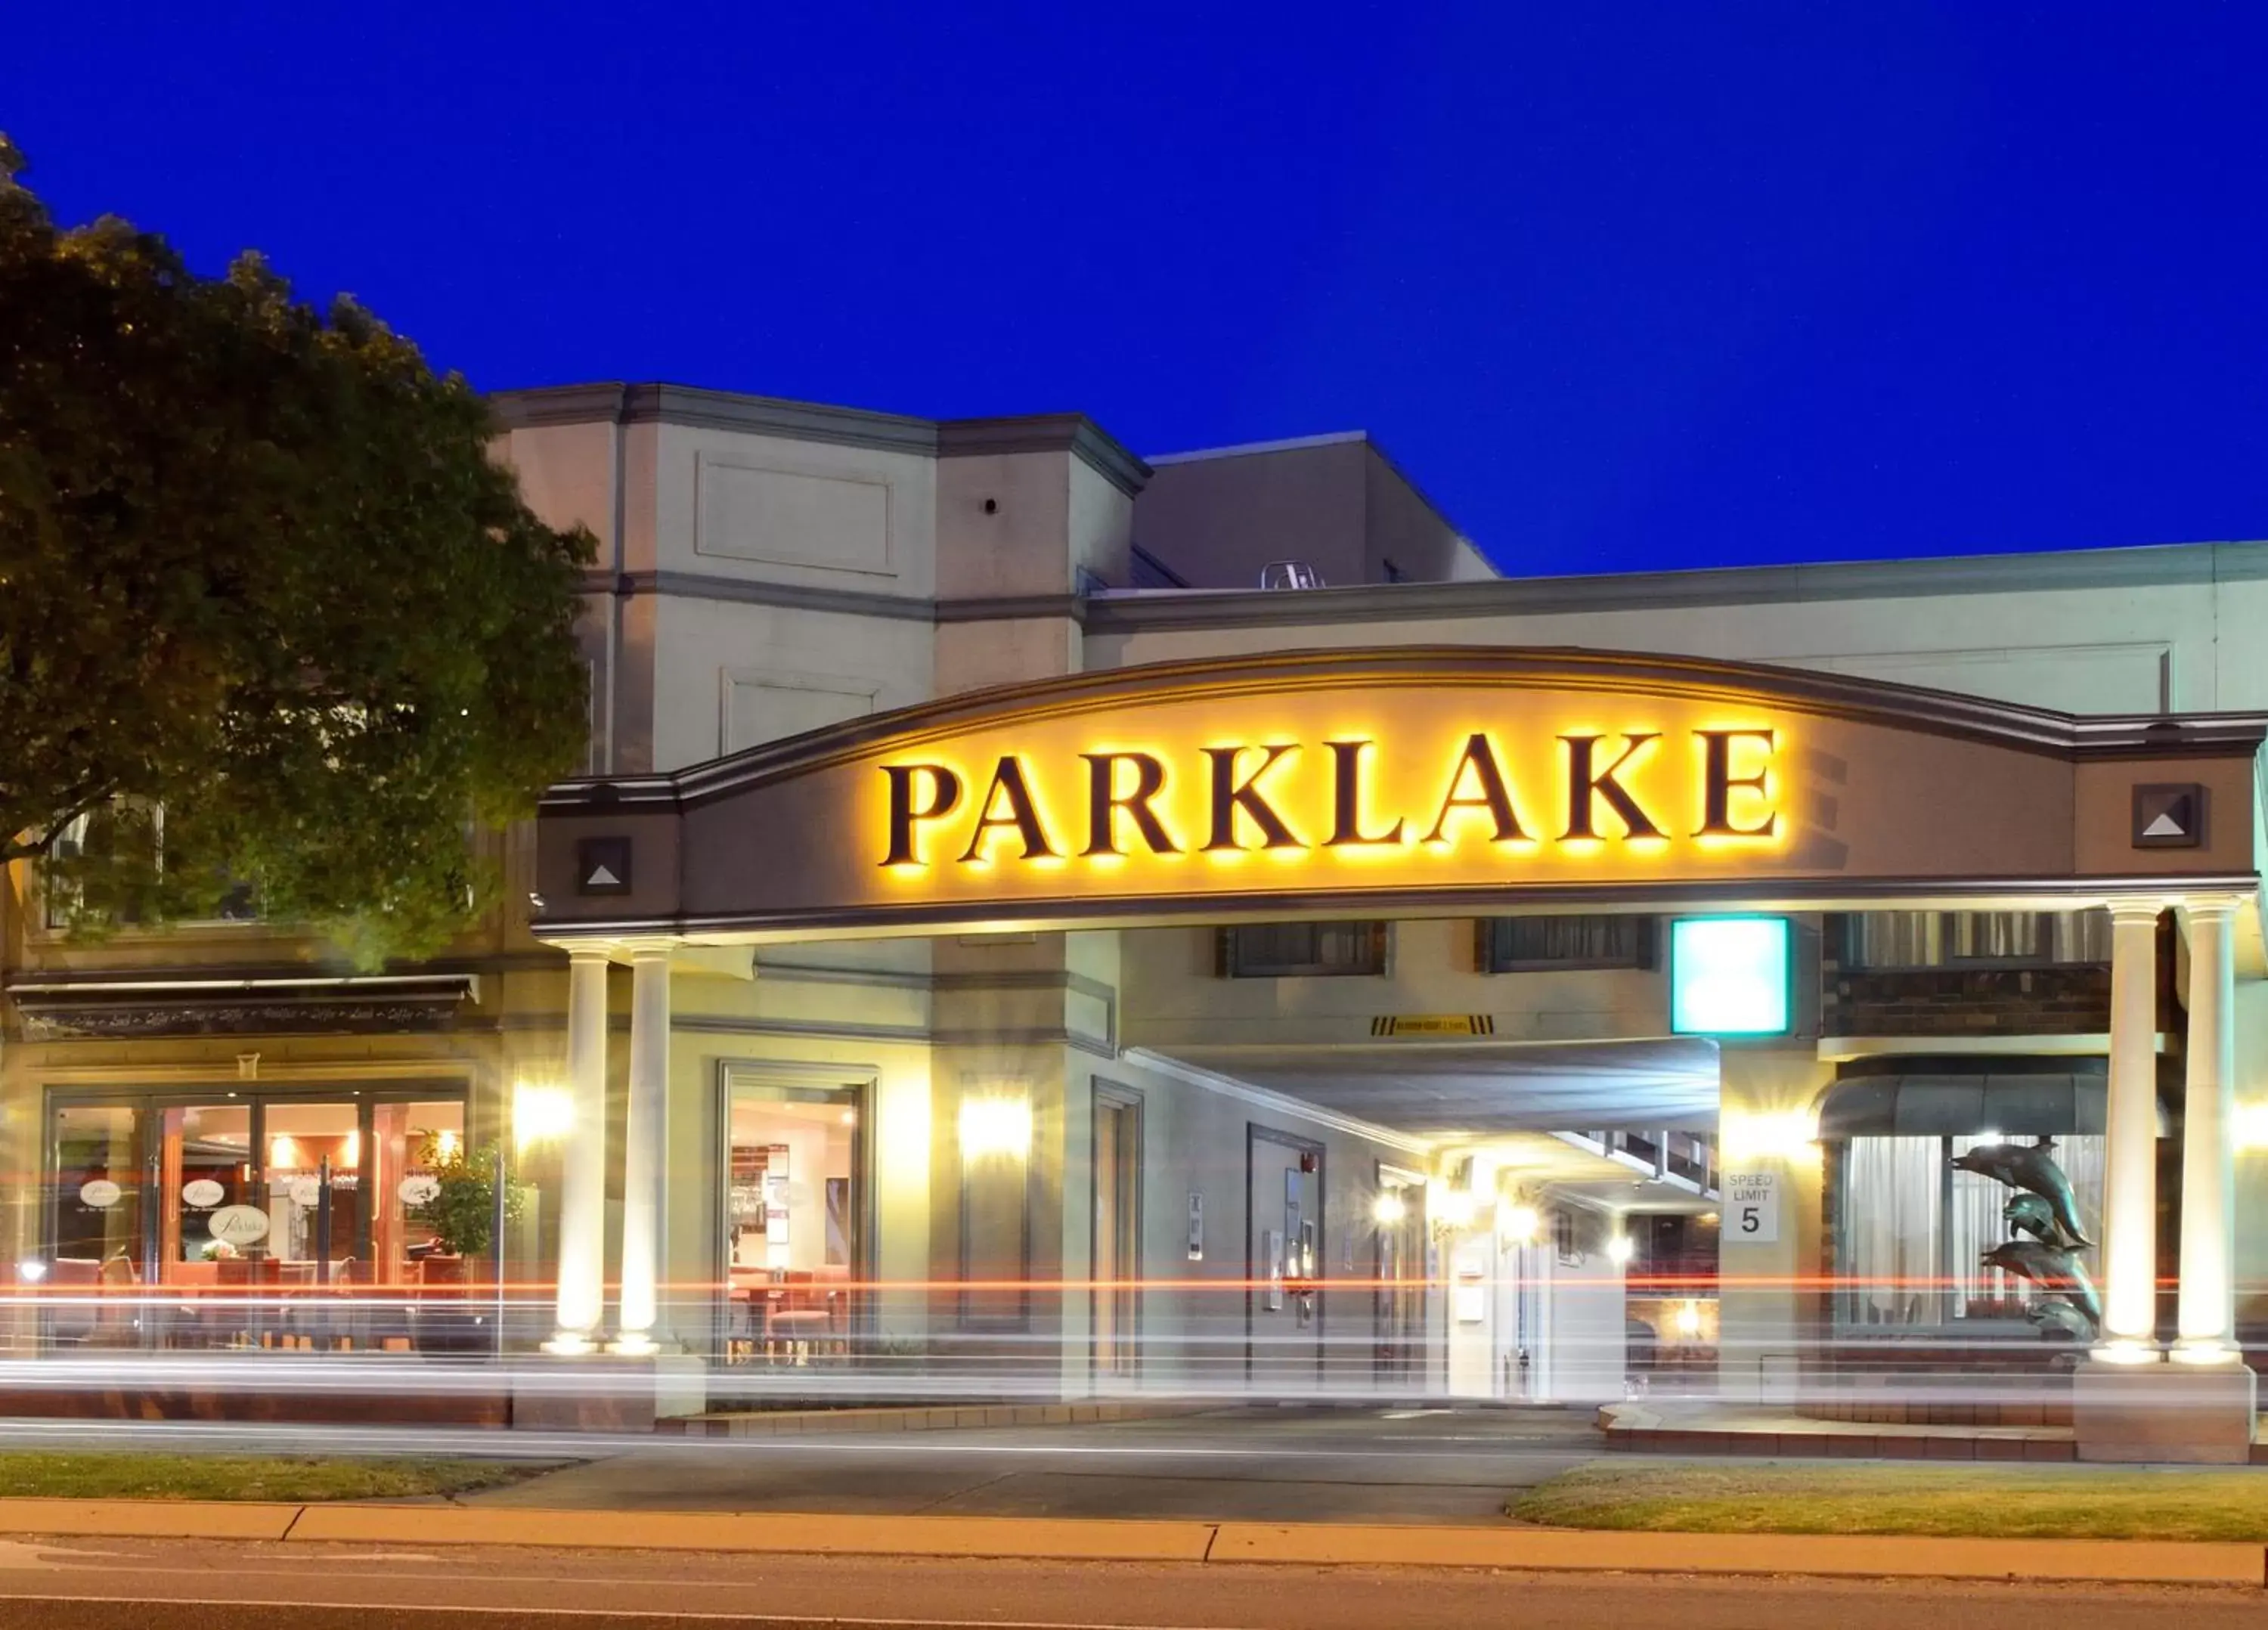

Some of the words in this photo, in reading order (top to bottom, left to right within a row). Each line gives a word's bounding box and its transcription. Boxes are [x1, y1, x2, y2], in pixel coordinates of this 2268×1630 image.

[877, 728, 1776, 867] PARKLAKE
[1729, 1174, 1773, 1186] SPEED
[1734, 1189, 1771, 1201] LIMIT
[1741, 1207, 1759, 1233] 5
